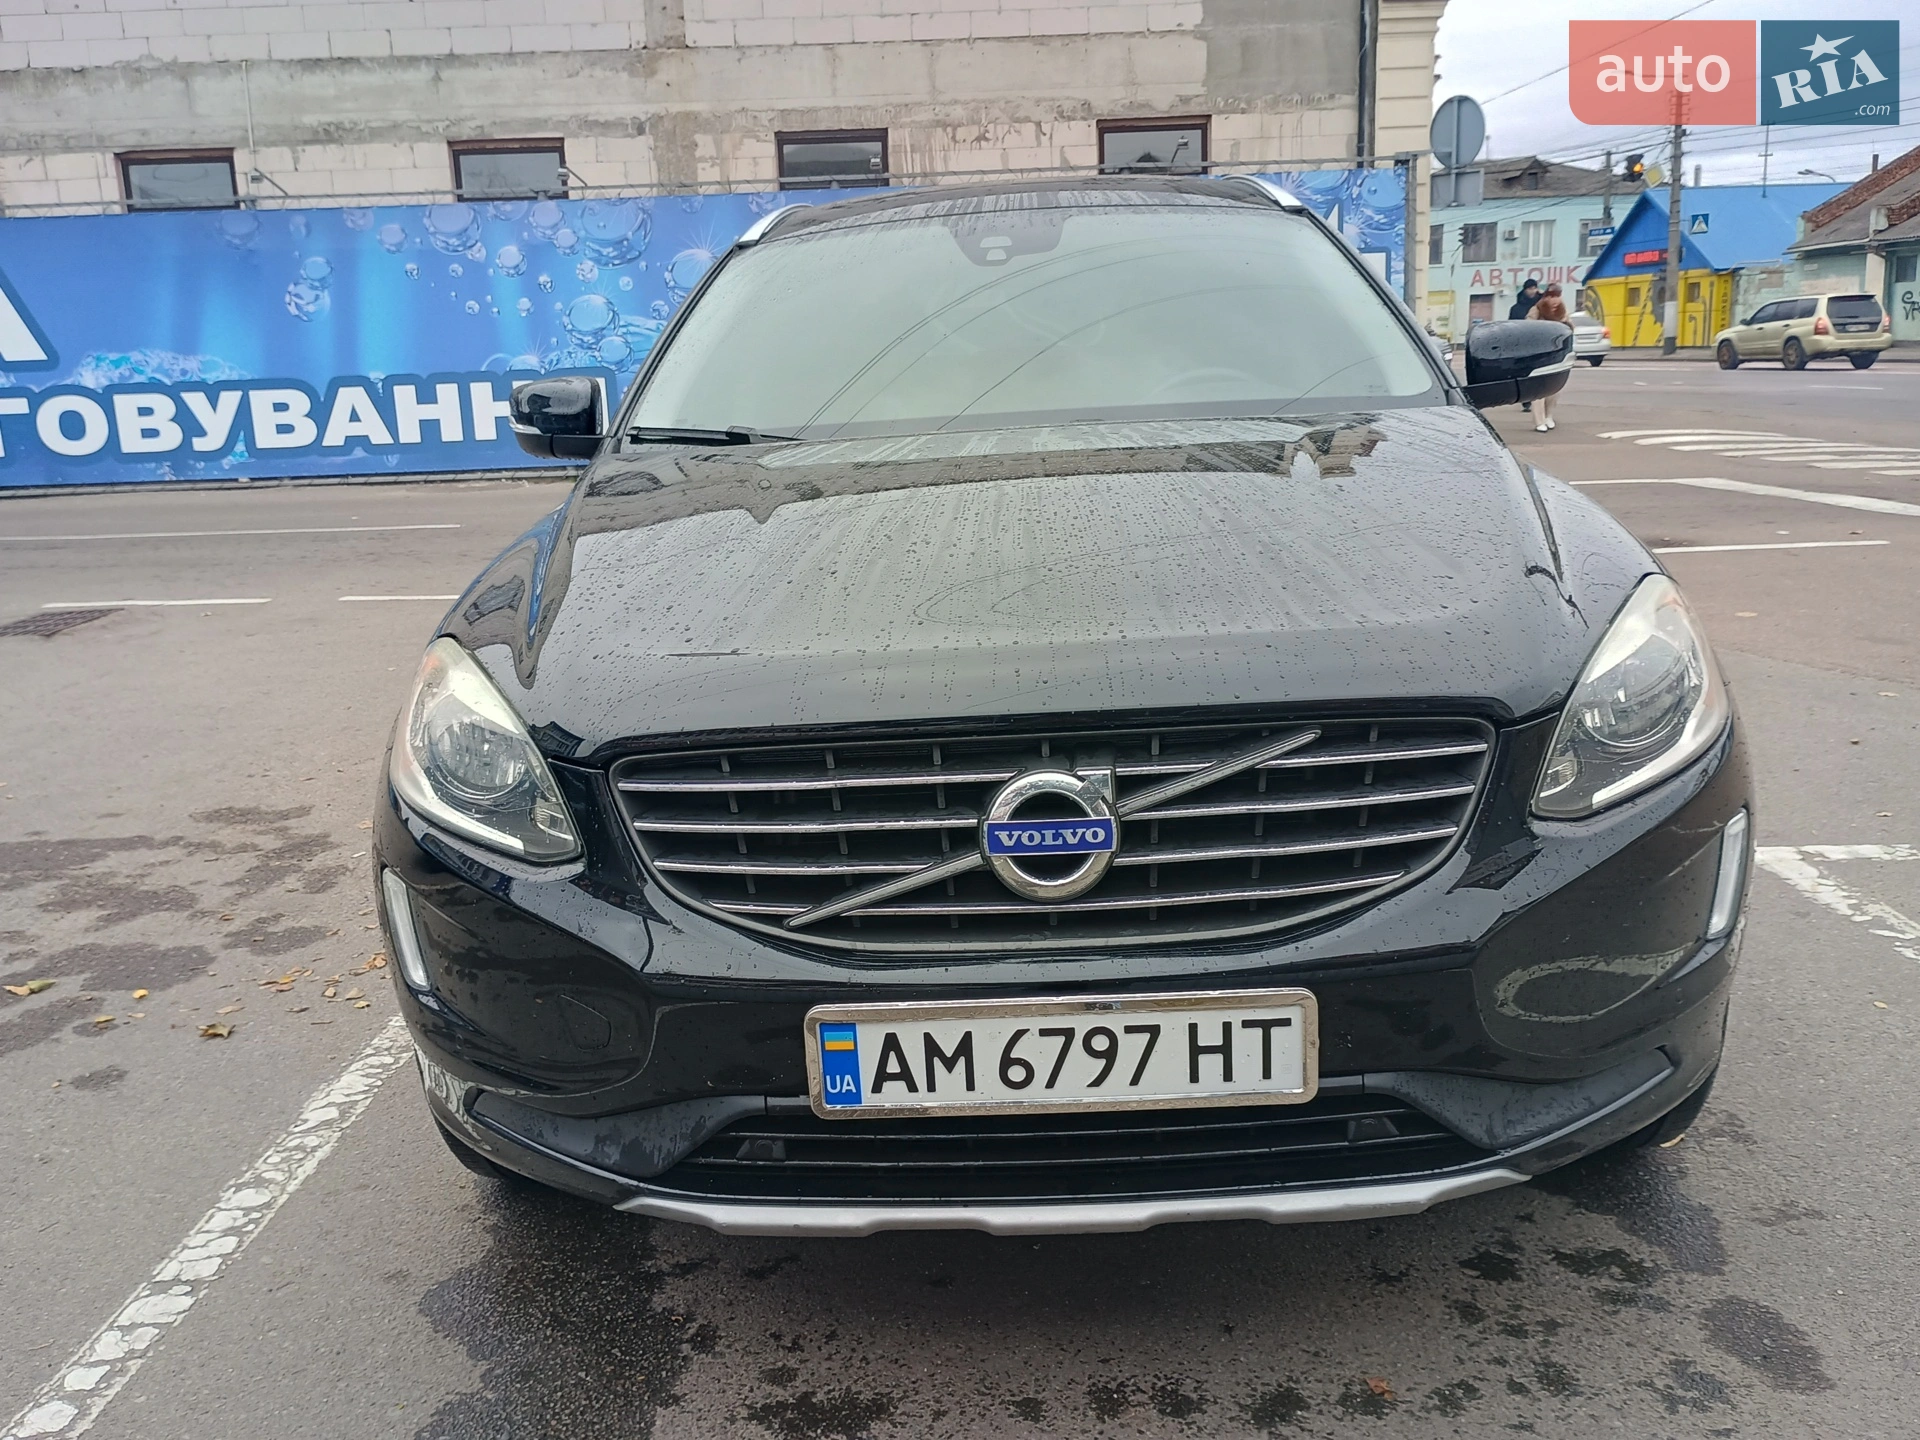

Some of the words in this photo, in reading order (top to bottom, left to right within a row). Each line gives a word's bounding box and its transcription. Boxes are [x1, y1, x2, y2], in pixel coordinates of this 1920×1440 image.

[1470, 265, 1594, 287] АВТОШК
[0, 379, 610, 458] ОВУВАНН
[995, 827, 1106, 848] VOLVO
[870, 1030, 977, 1094] AM
[998, 1023, 1162, 1090] 6797
[1187, 1017, 1292, 1085] HT
[826, 1074, 857, 1095] UA
